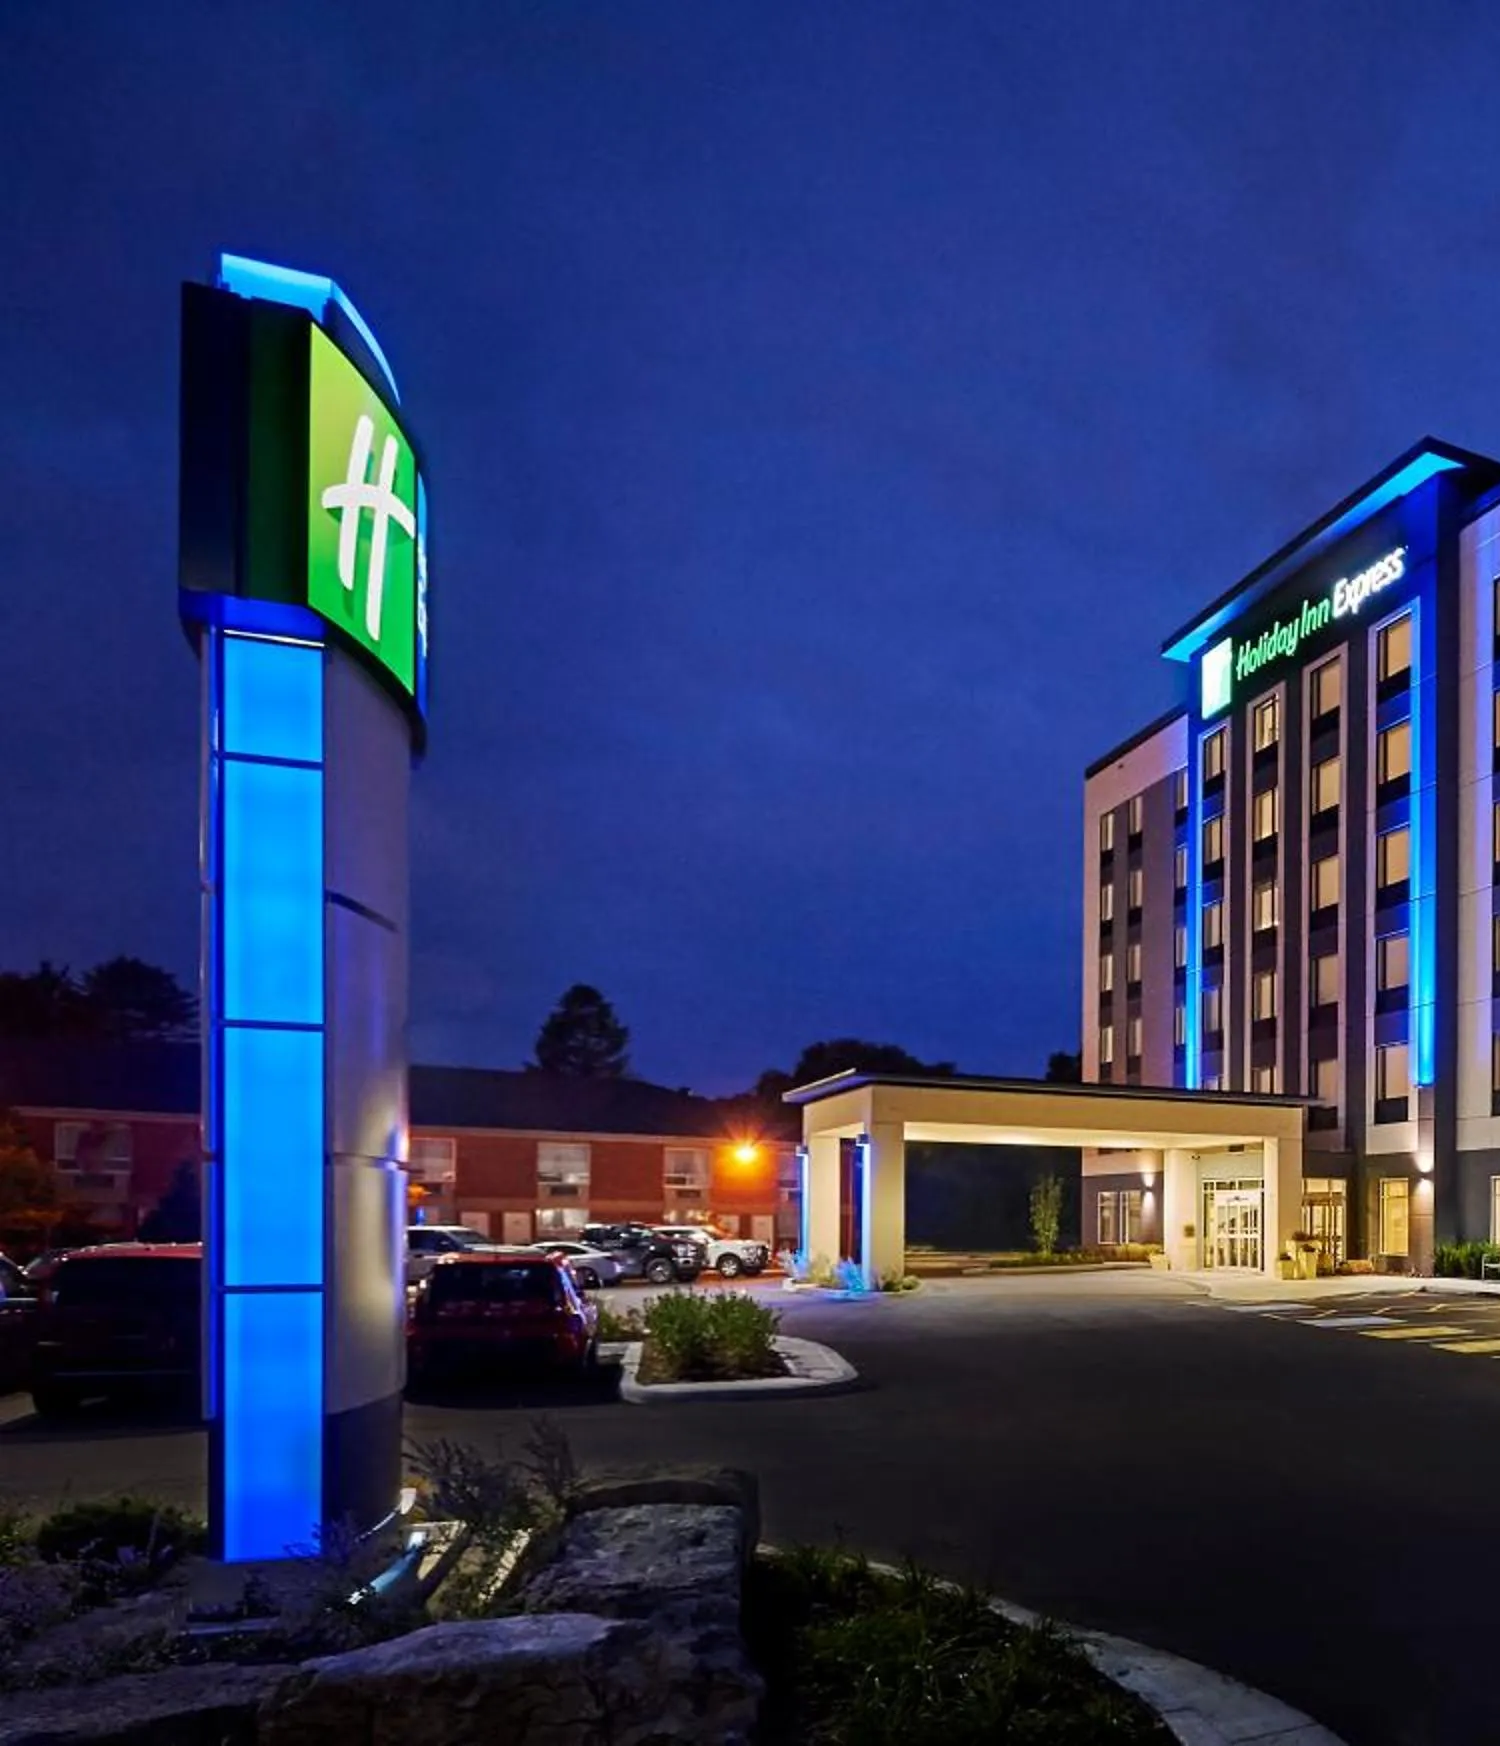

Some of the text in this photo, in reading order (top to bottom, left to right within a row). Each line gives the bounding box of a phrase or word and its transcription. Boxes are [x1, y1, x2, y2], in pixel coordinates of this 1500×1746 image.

[322, 414, 416, 642] H
[1235, 617, 1300, 681] Holiday
[1300, 599, 1331, 639] Inn
[1332, 546, 1405, 619] Express
